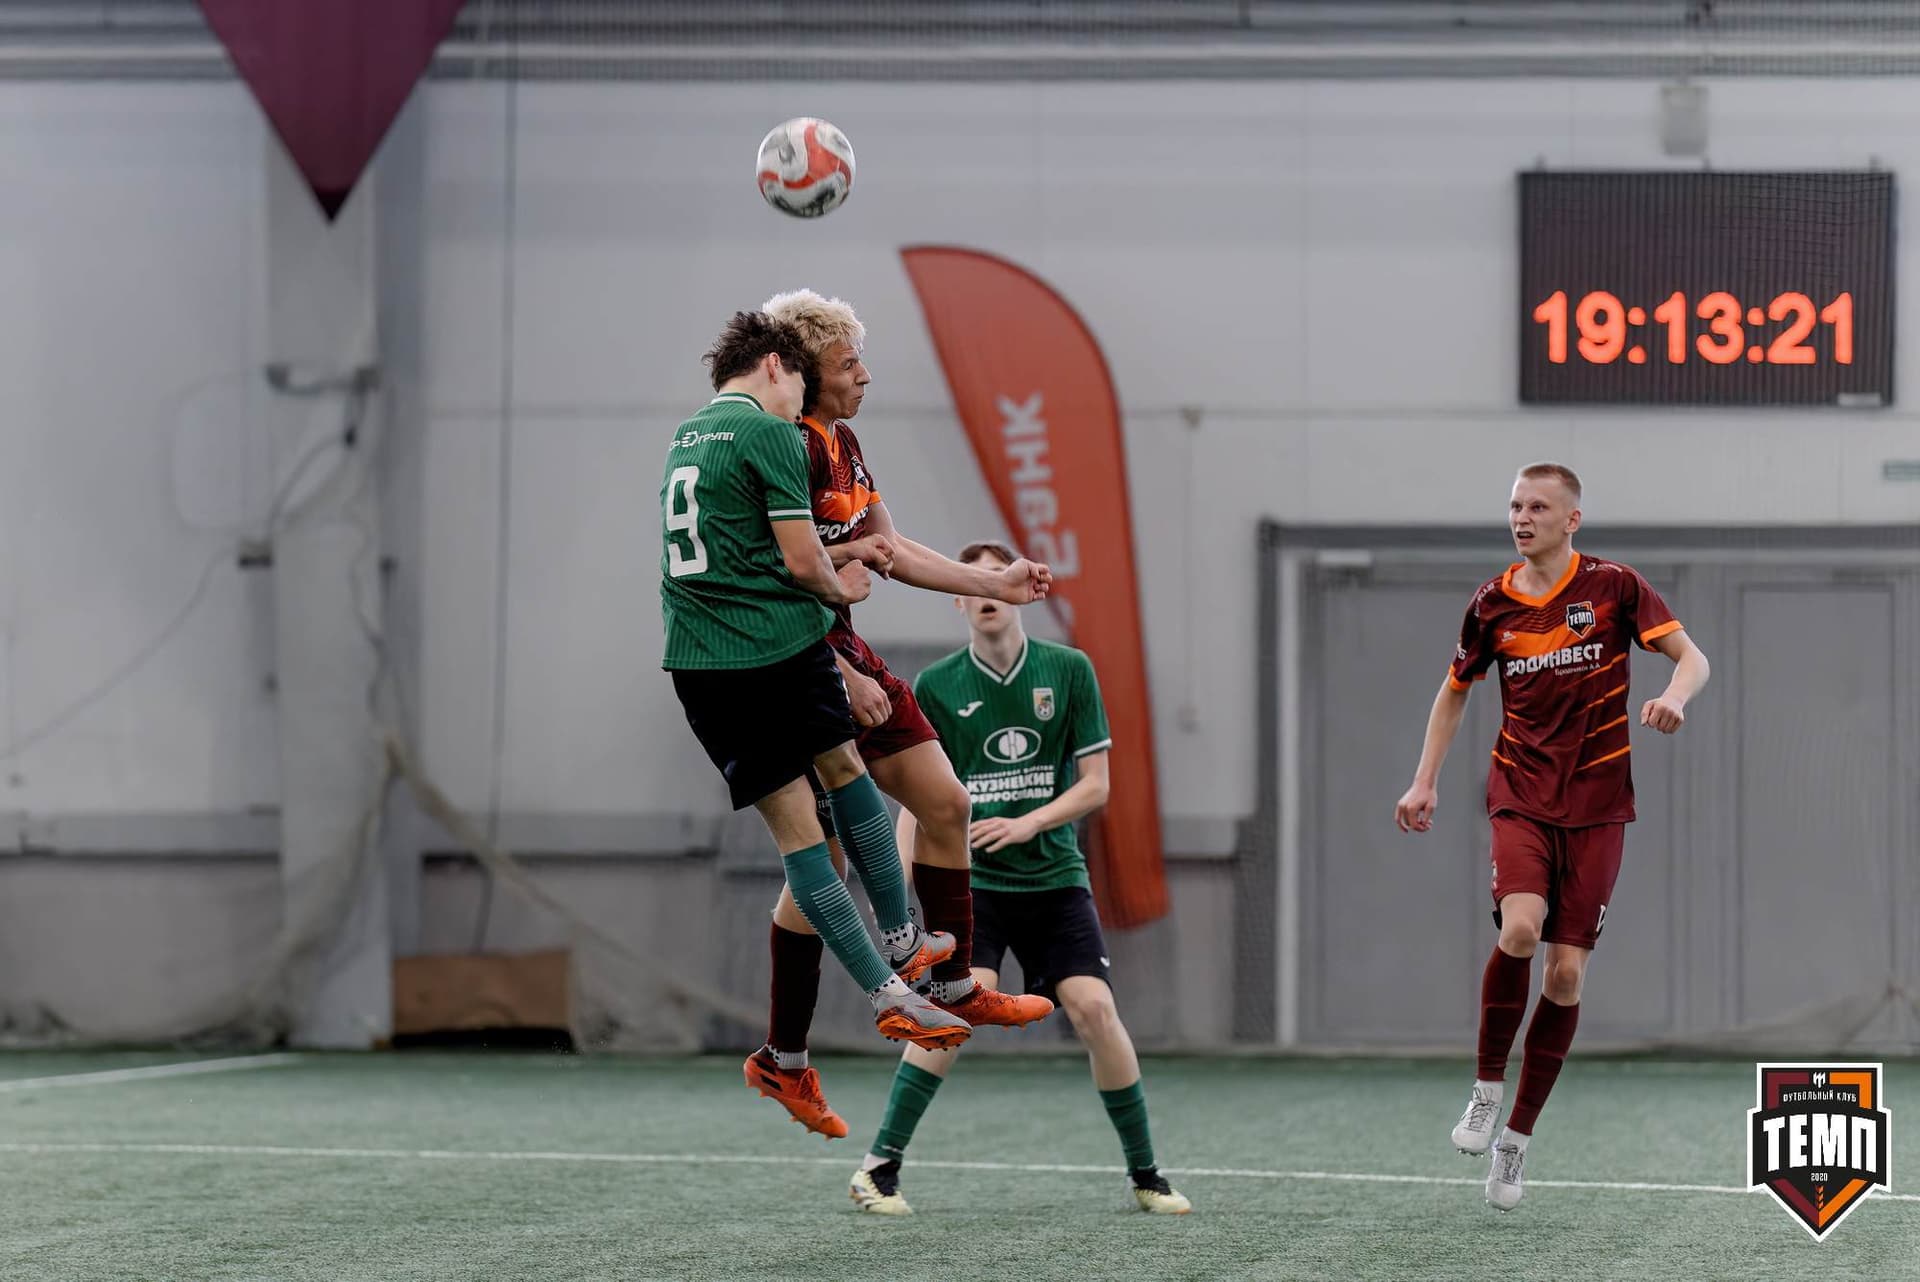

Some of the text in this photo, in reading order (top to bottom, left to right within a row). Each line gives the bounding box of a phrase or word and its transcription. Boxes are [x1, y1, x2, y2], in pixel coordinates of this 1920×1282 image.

[1532, 290, 1855, 365] 19:13:21
[666, 465, 707, 577] 9
[1569, 611, 1592, 626] ТЕМП
[967, 772, 1055, 793] КУЗНЕЦКИЕ
